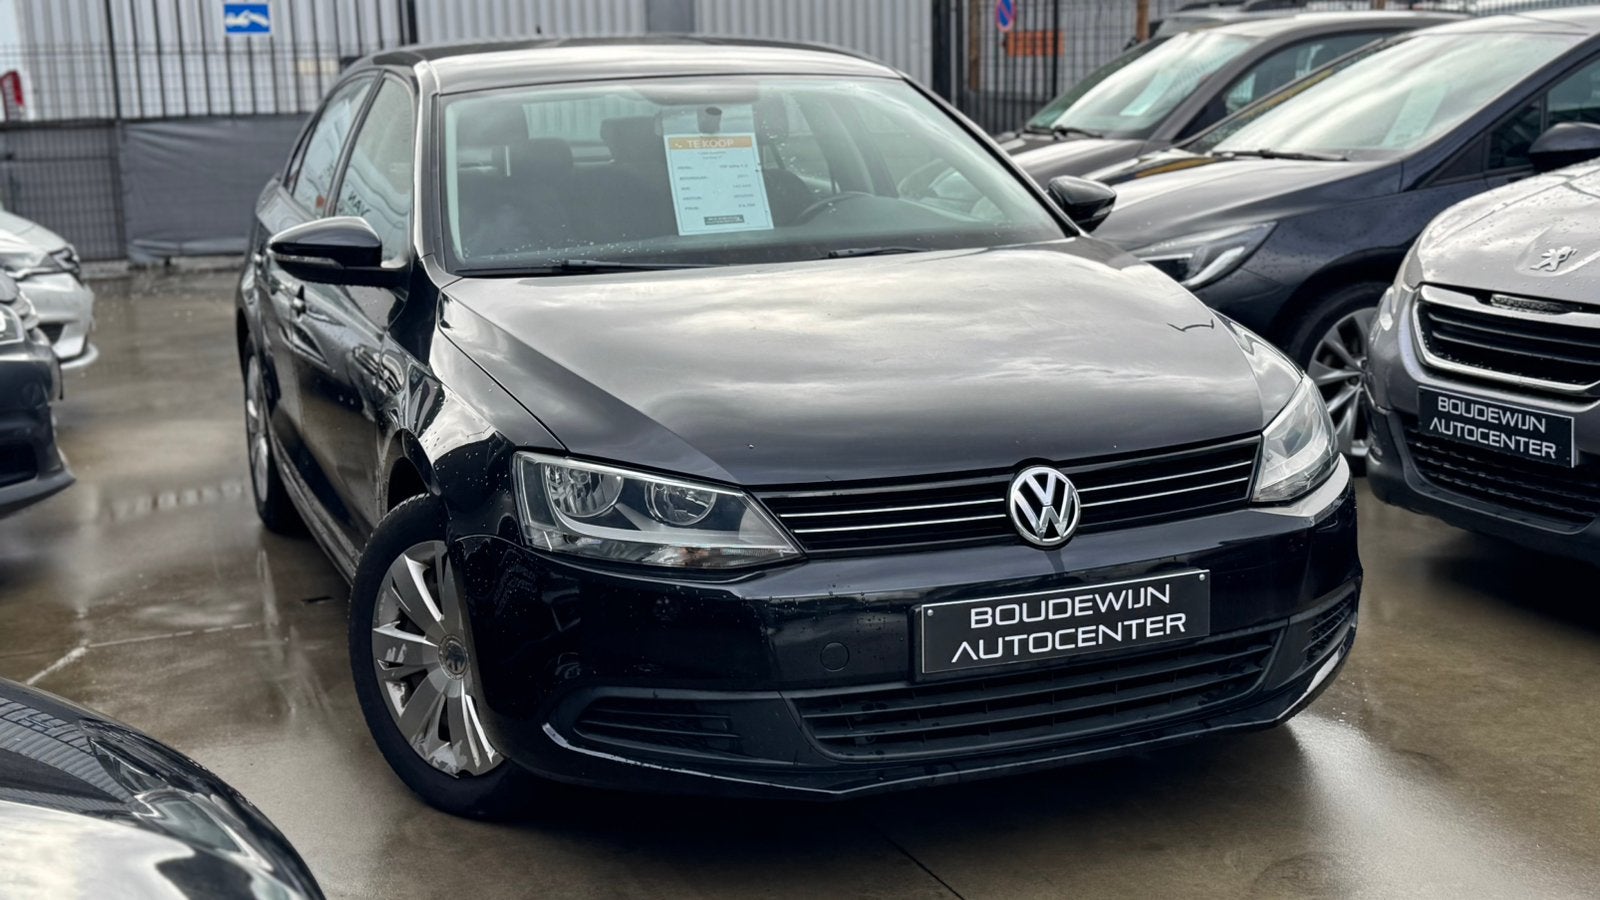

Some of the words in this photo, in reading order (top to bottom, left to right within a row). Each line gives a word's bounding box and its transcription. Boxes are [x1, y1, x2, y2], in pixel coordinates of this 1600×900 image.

[1438, 397, 1546, 432] BOUDEWIJN
[1430, 417, 1556, 459] AUTOCENTER
[1011, 466, 1080, 545] VW
[970, 584, 1170, 629] BOUDEWIJN
[951, 613, 1186, 662] AUTOCENTER
